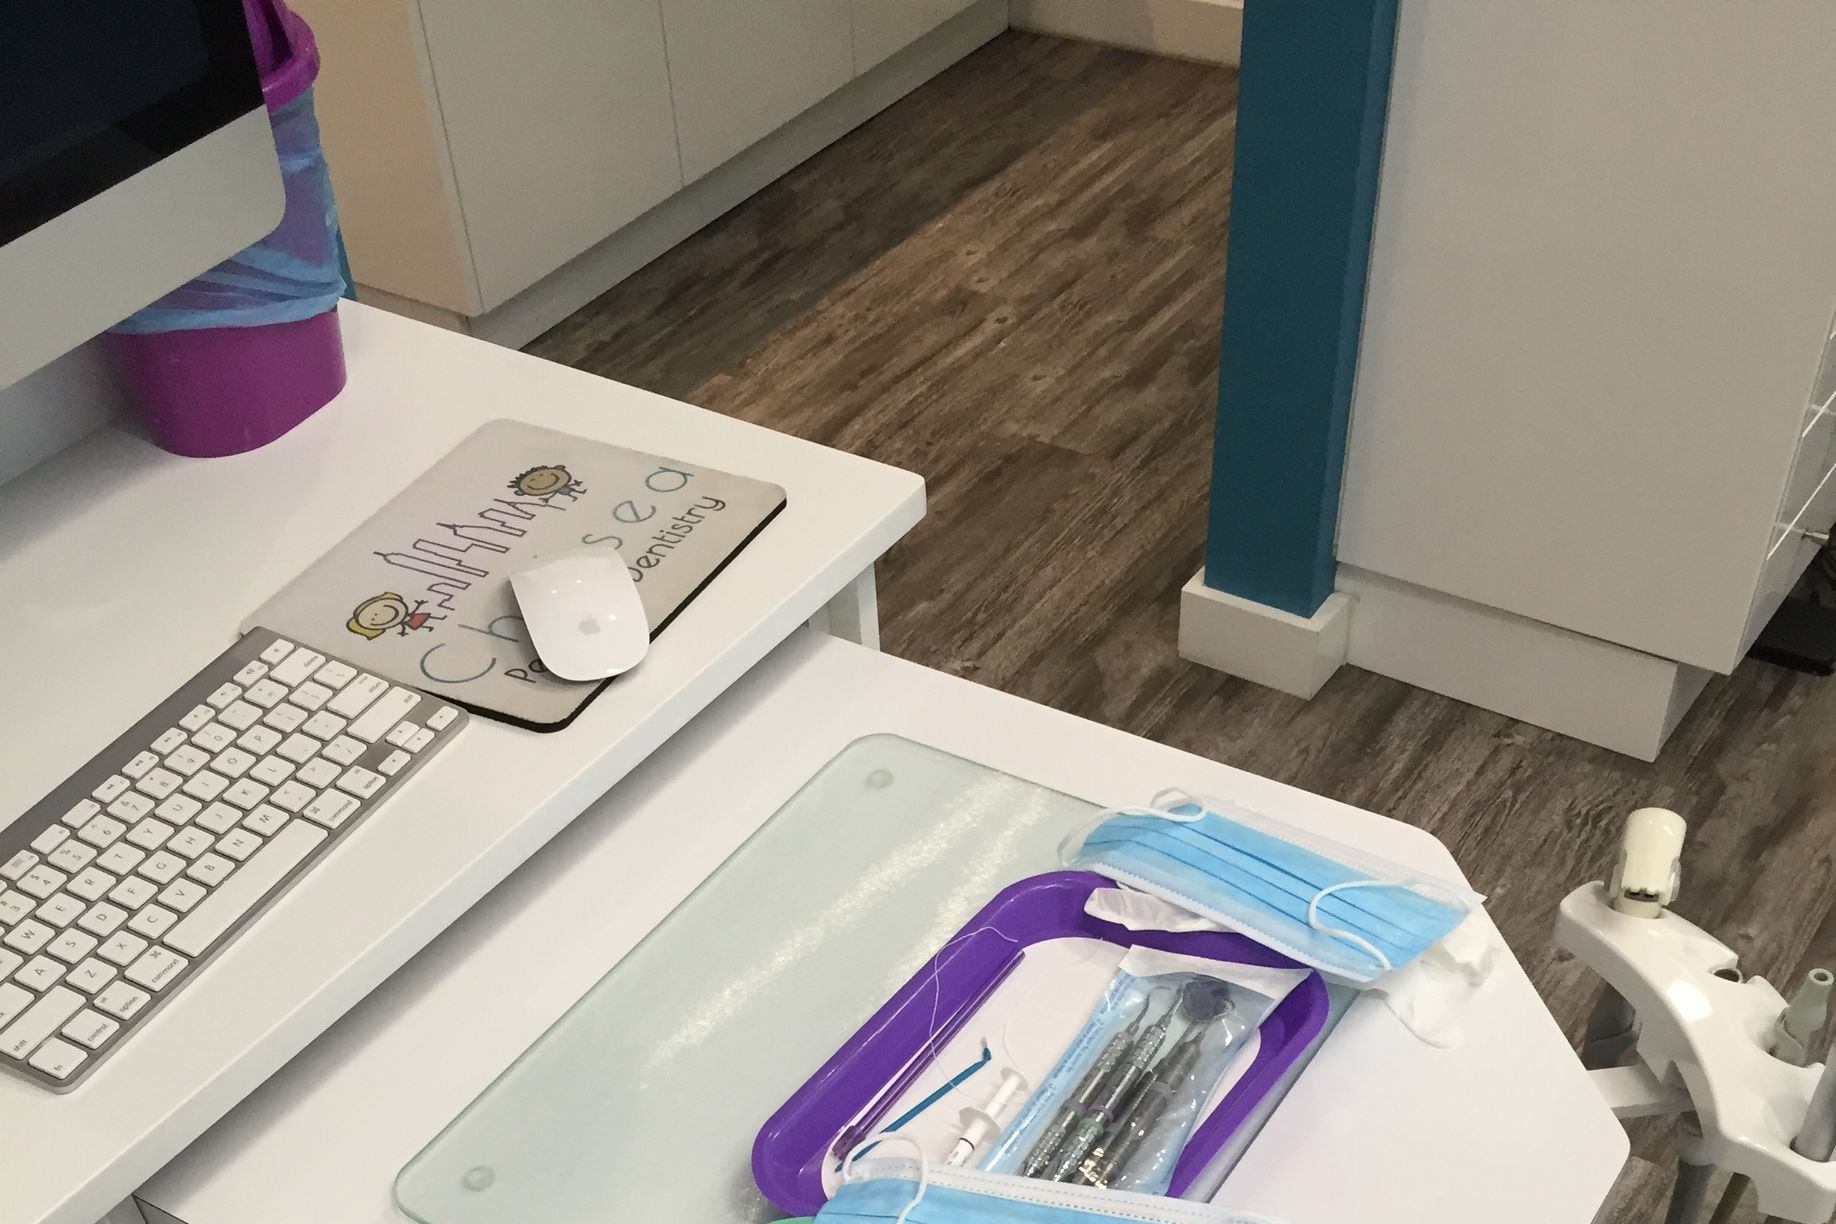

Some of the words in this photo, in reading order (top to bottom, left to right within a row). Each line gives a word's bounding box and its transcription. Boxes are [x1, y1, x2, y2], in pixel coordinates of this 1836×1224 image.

[152, 959, 180, 984] command
[120, 996, 138, 1013] option
[88, 1023, 108, 1042] control
